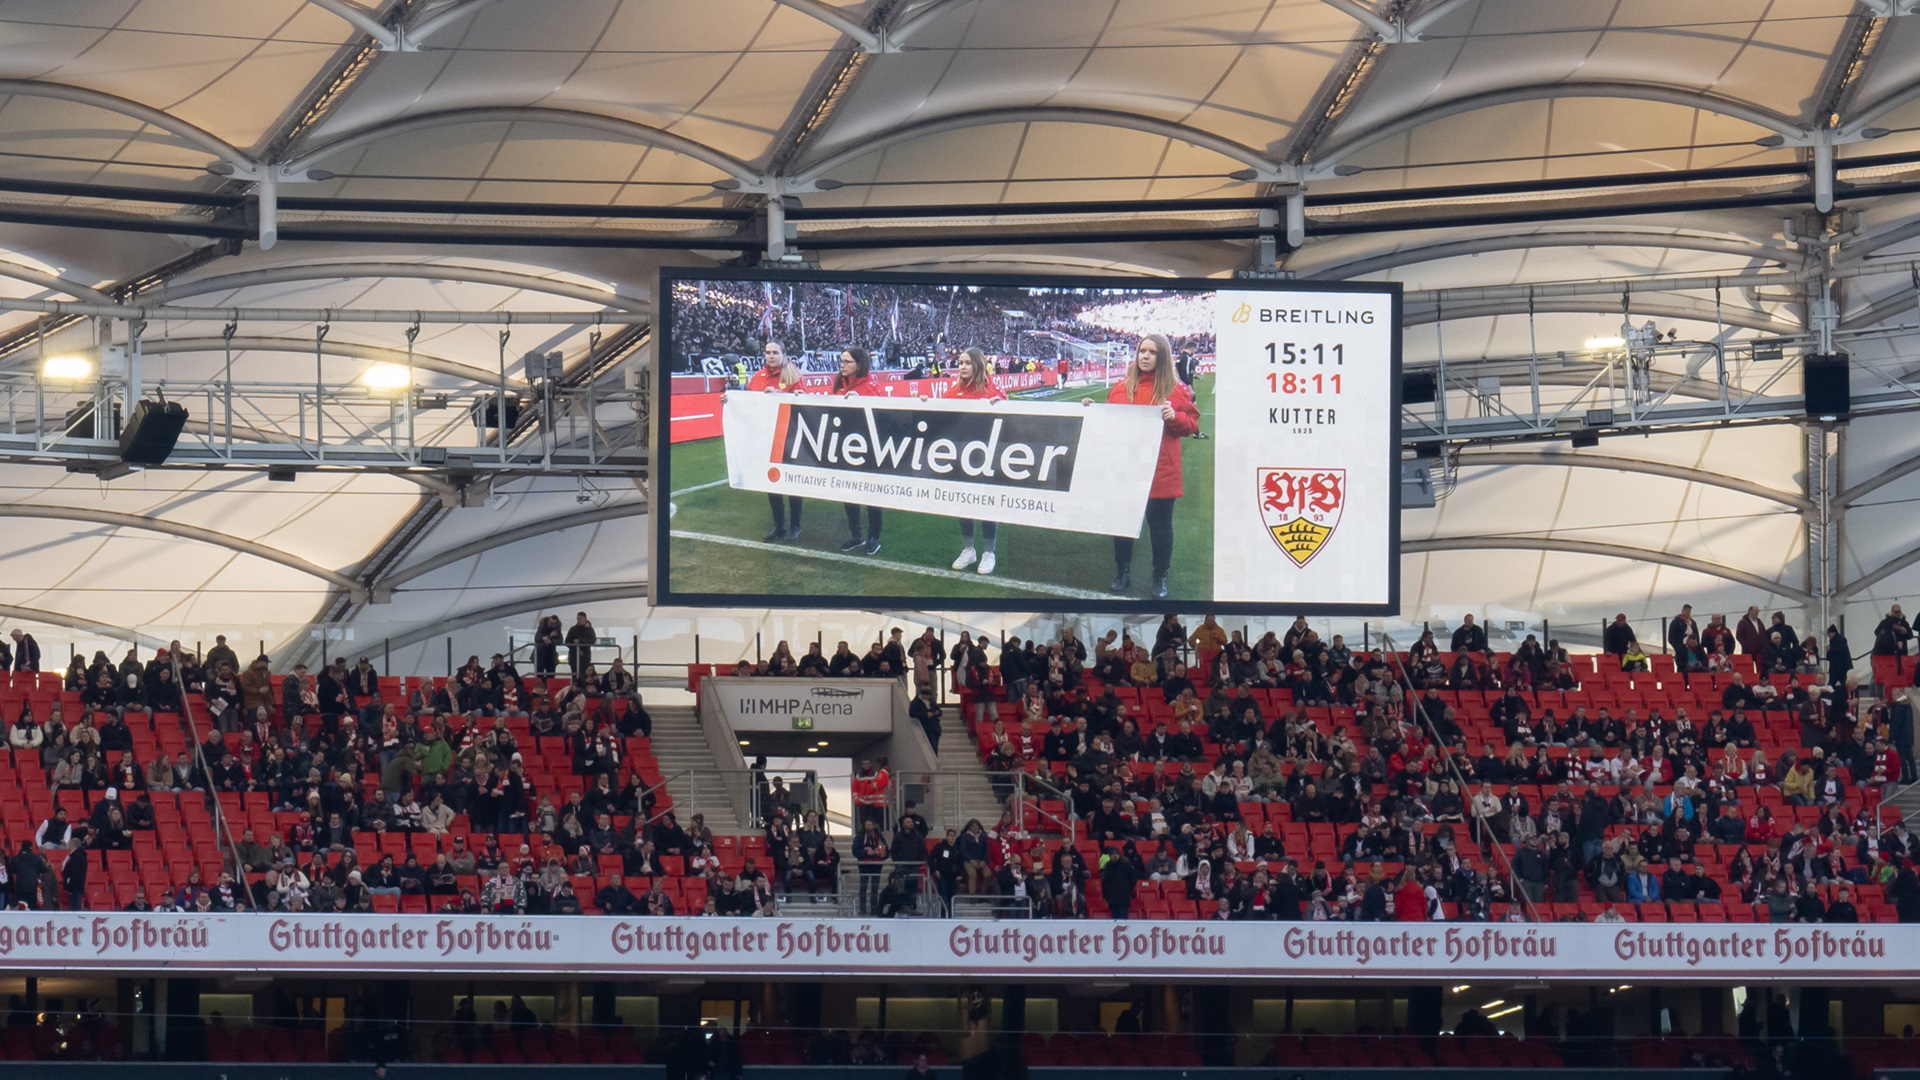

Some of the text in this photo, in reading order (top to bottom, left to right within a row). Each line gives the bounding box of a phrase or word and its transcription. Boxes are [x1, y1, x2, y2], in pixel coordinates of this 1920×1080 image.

[1260, 308, 1374, 325] BREITLING
[1264, 342, 1343, 365] 15:11
[1266, 372, 1342, 395] 18:11
[1269, 407, 1336, 425] KUTTER
[759, 698, 853, 716] MHP Arena
[91, 916, 209, 953] Hofbräu
[269, 919, 551, 958] Stuttgarter Hofbräu
[611, 922, 890, 960] Stuttgarter Hofbräu
[950, 925, 1225, 963] Stuttgarter Hofbräu
[1284, 927, 1556, 965] Stuttgarter Hofbräu
[1614, 928, 1885, 966] Stuttgarter Hofbräu
